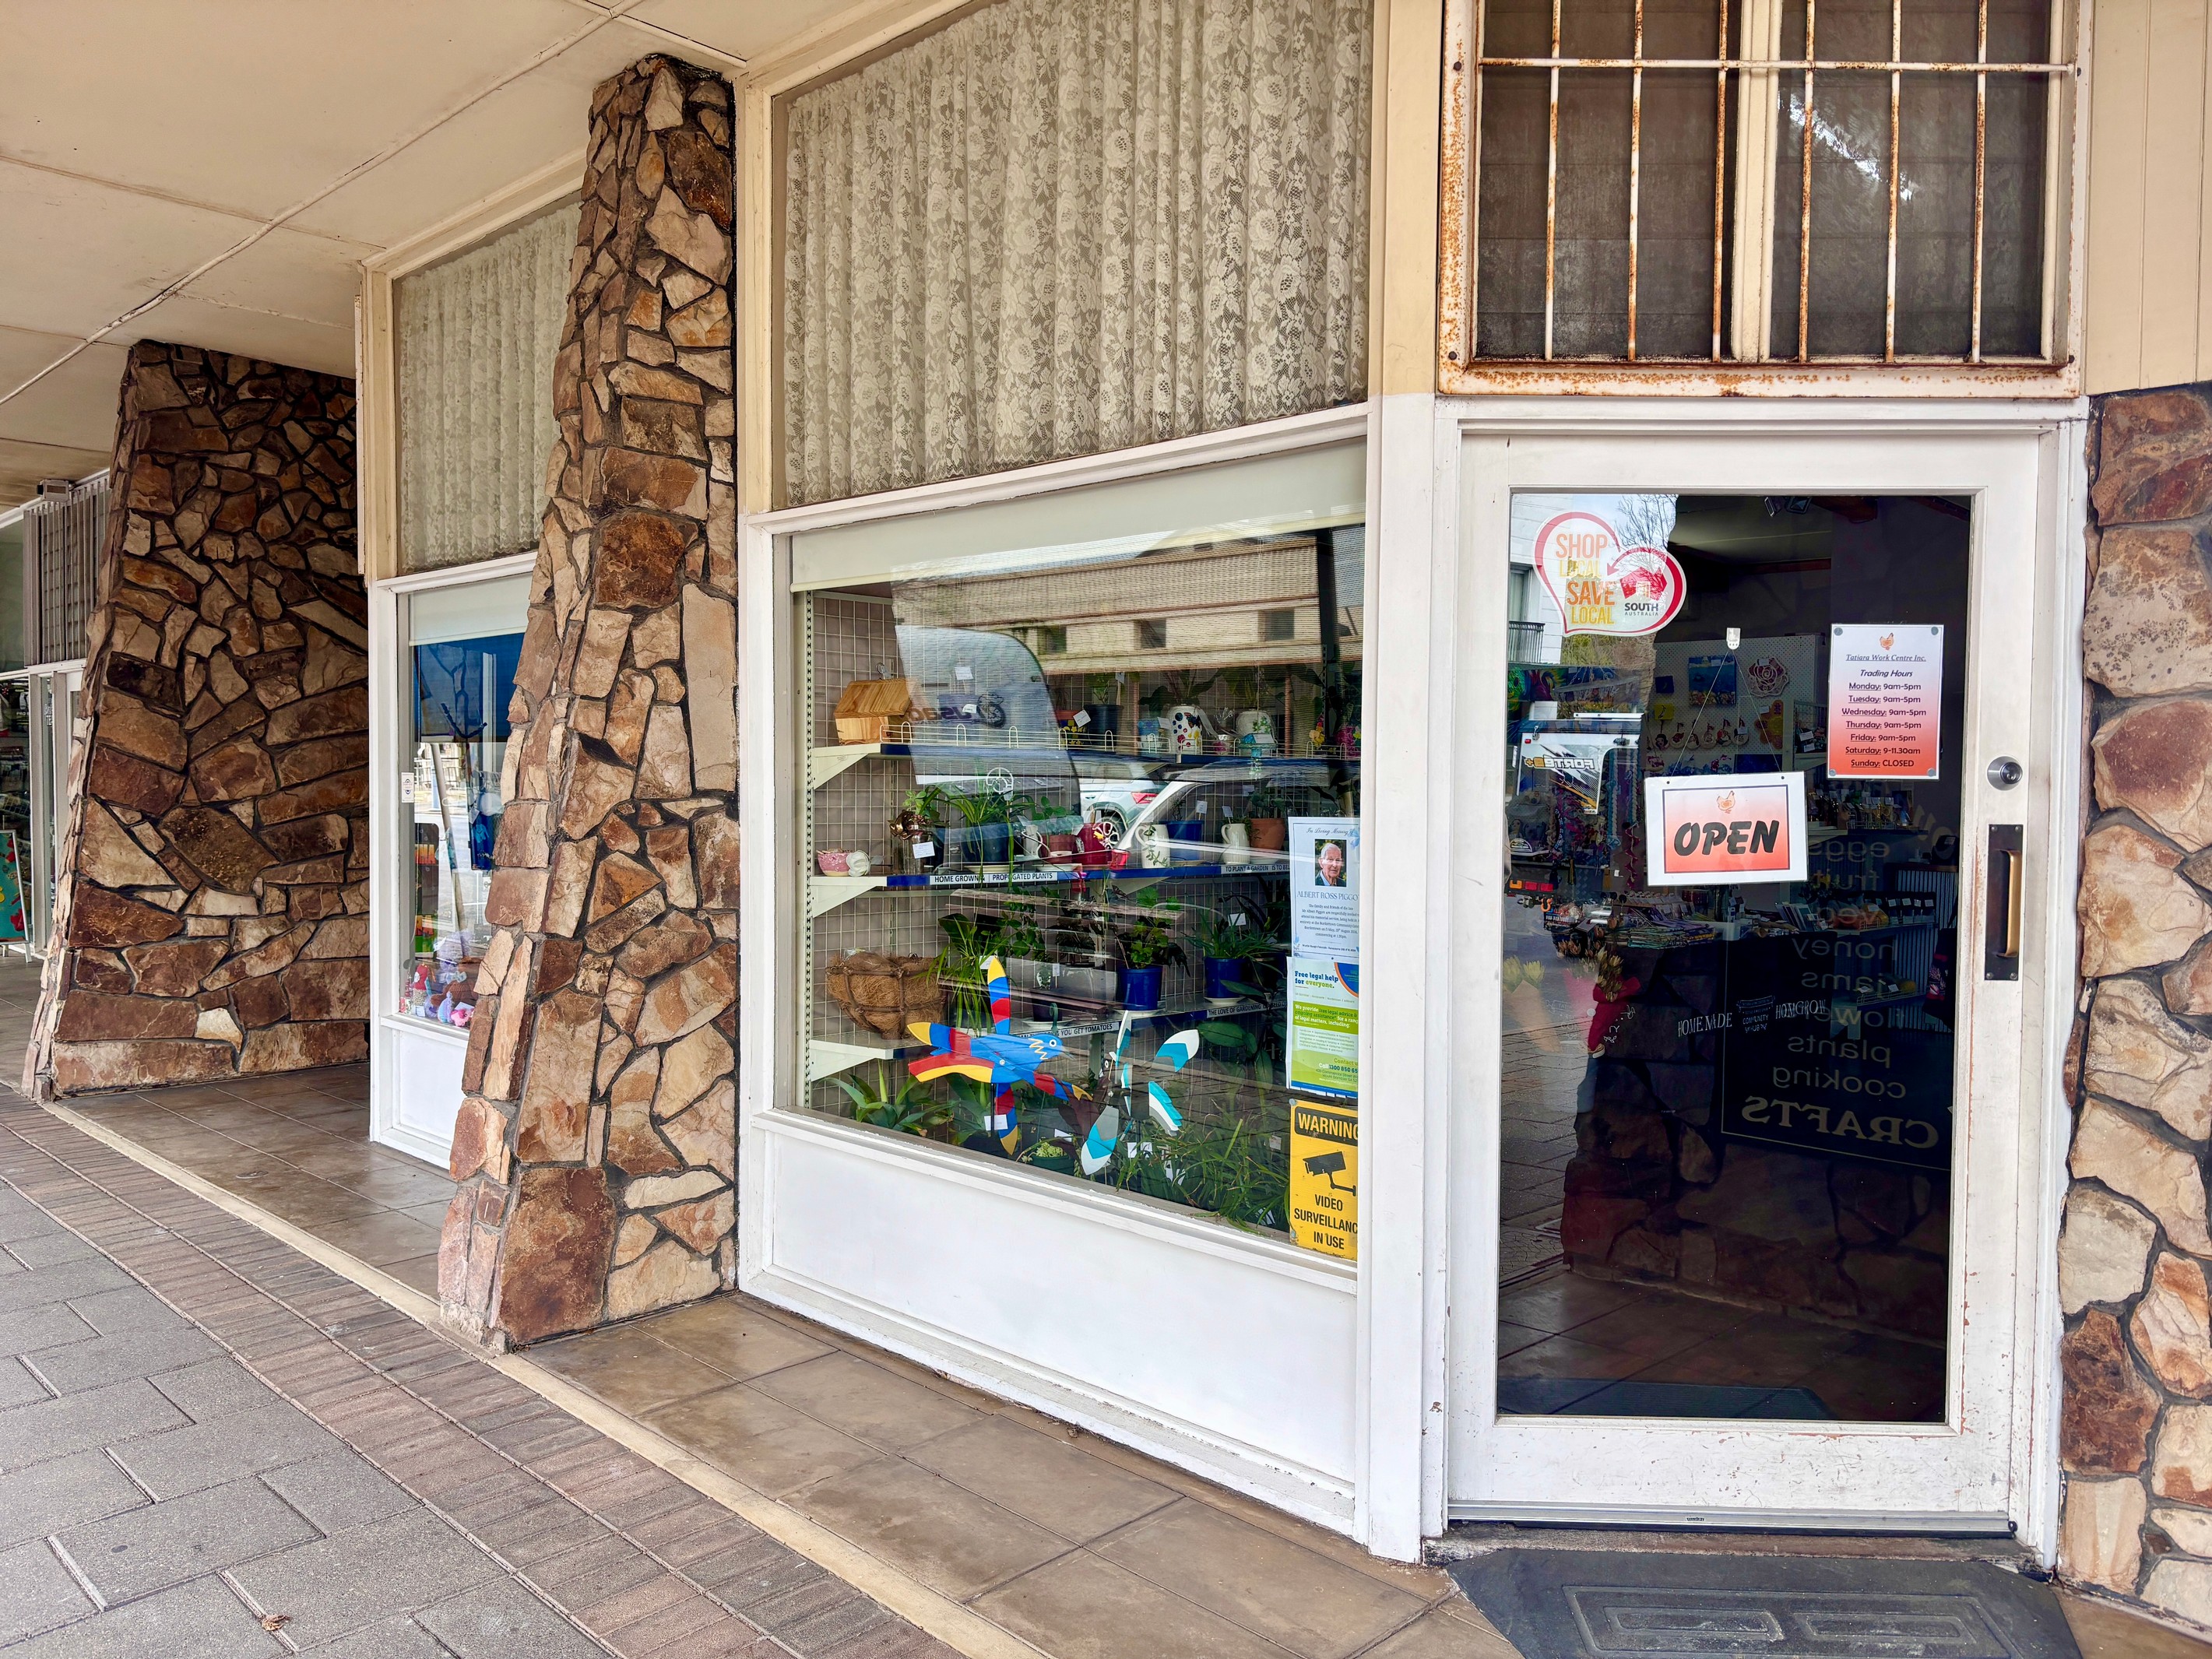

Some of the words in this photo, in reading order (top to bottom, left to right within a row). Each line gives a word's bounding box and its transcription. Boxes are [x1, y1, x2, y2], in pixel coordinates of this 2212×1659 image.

[1556, 533, 1608, 559] SHOP
[1559, 559, 1602, 578] LOCAL
[1567, 580, 1616, 606] SAVE
[1570, 606, 1615, 625] LOCAL
[1625, 603, 1658, 612] SOUTH
[1841, 708, 1887, 716] Wednesday:
[1845, 747, 1881, 755] Saturday:
[1674, 820, 1780, 856] OPEN
[1306, 980, 1335, 989] everyone.
[1325, 974, 1338, 982] help
[1085, 1024, 1113, 1033] TOMATOES
[1315, 1194, 1343, 1211] VIDEO
[1294, 1207, 1358, 1234] SURVEILLANC
[1313, 1231, 1323, 1244] IN
[1327, 1233, 1345, 1250] USE
